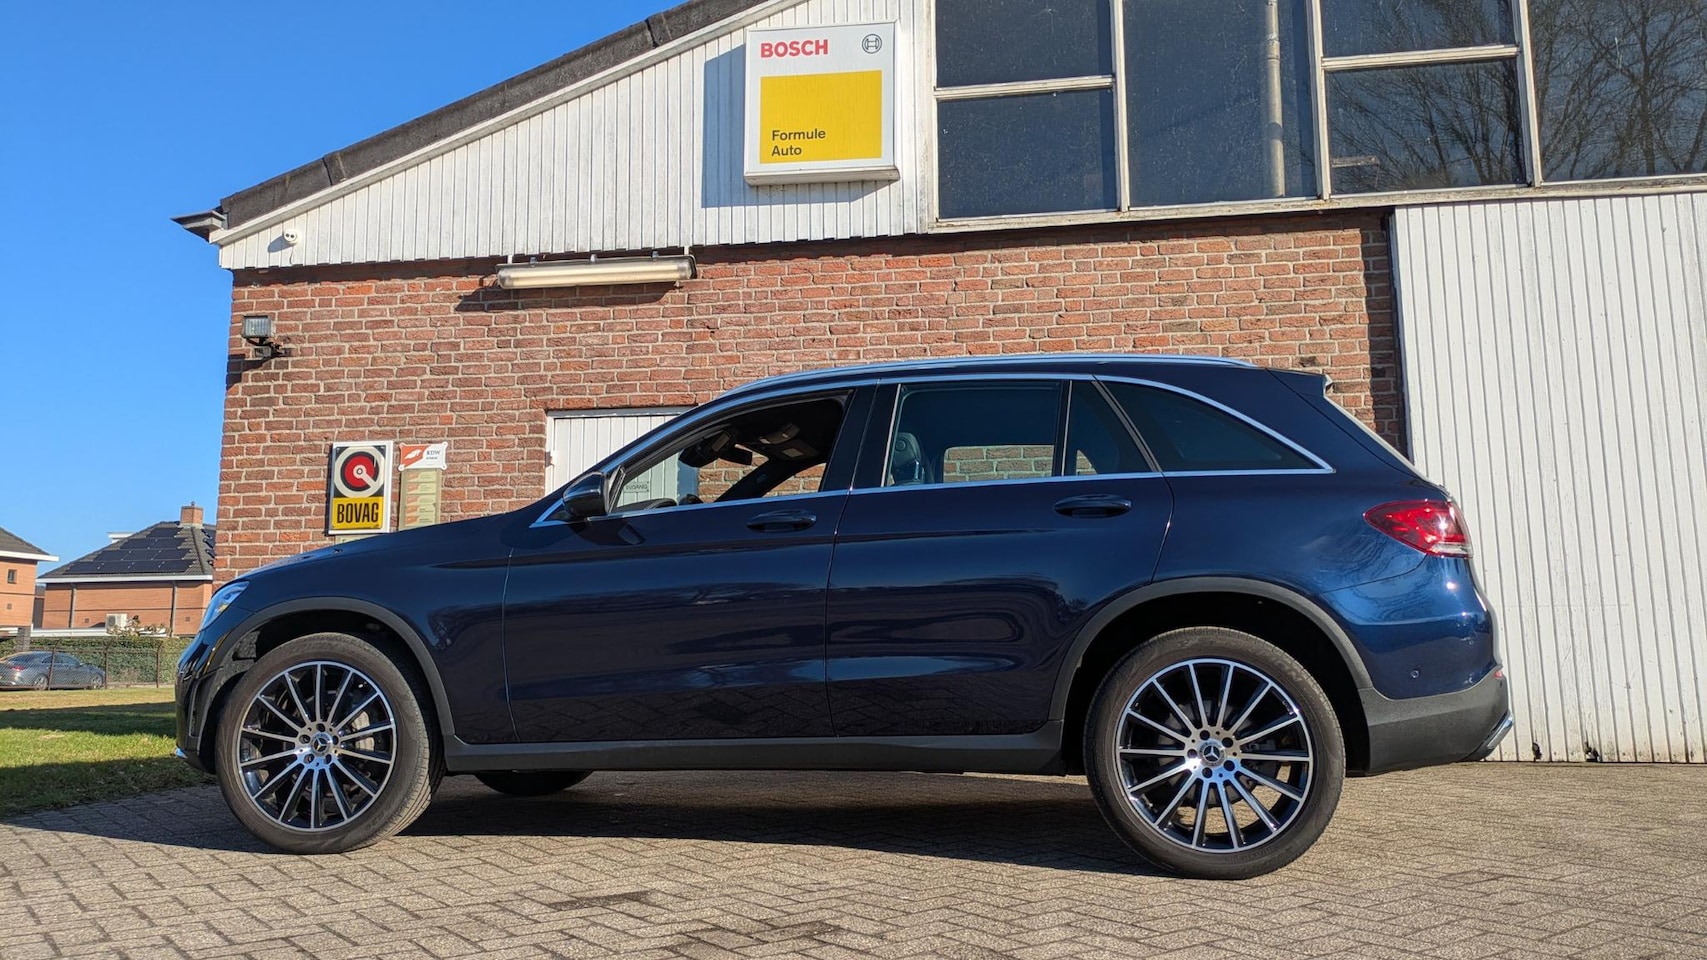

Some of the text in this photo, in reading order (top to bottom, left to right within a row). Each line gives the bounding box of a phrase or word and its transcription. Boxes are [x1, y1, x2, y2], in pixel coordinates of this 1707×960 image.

[760, 39, 829, 58] BOSCH
[772, 128, 826, 141] Formule
[771, 145, 802, 157] Auto
[336, 502, 379, 524] BOVAG
